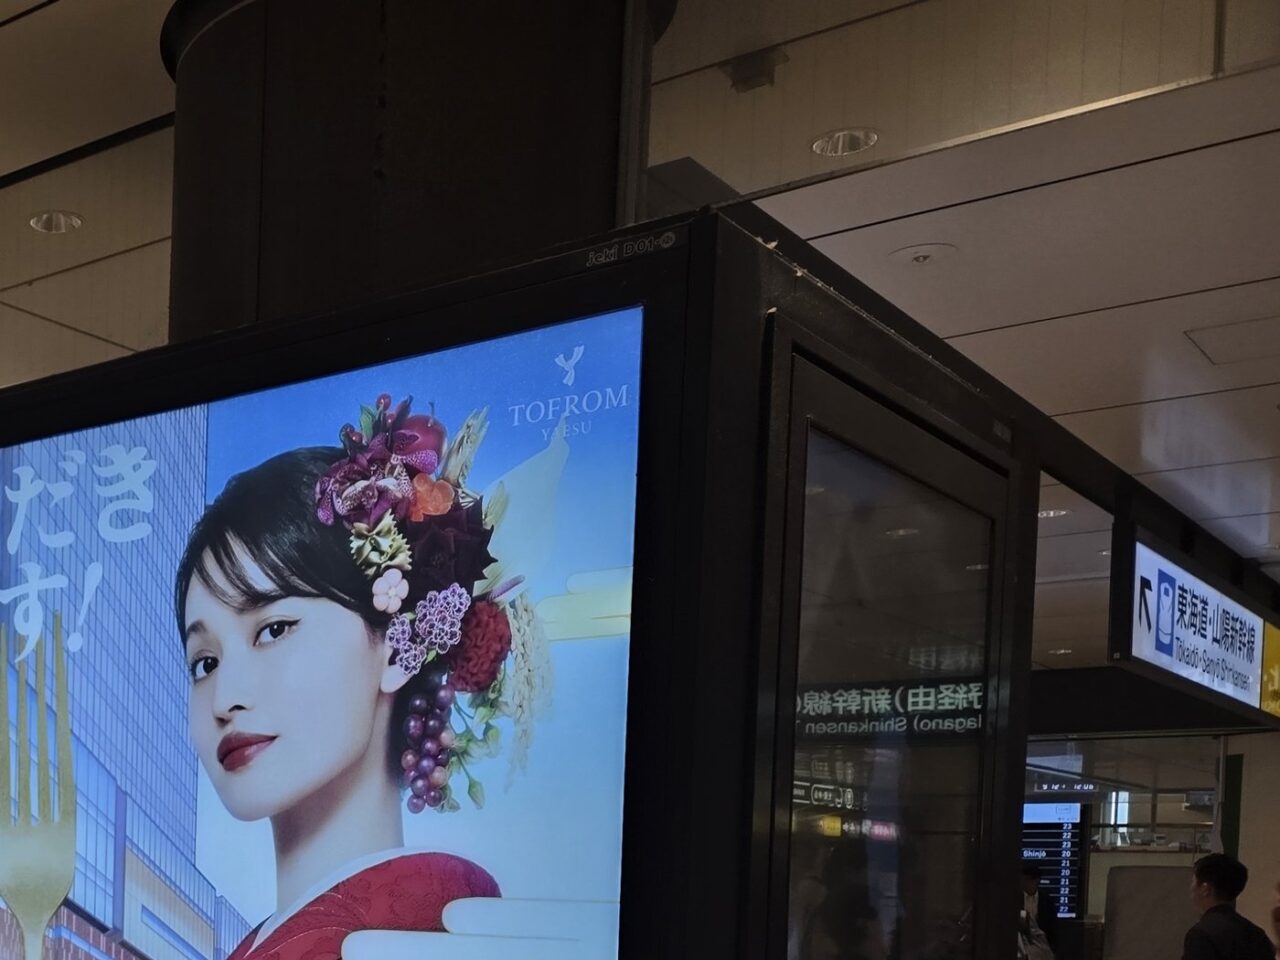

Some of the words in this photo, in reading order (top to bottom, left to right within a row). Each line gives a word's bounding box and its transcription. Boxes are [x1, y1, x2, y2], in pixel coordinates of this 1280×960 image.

[508, 384, 629, 427] TOFROM
[1176, 583, 1256, 665] 東海道・山陽新幹線
